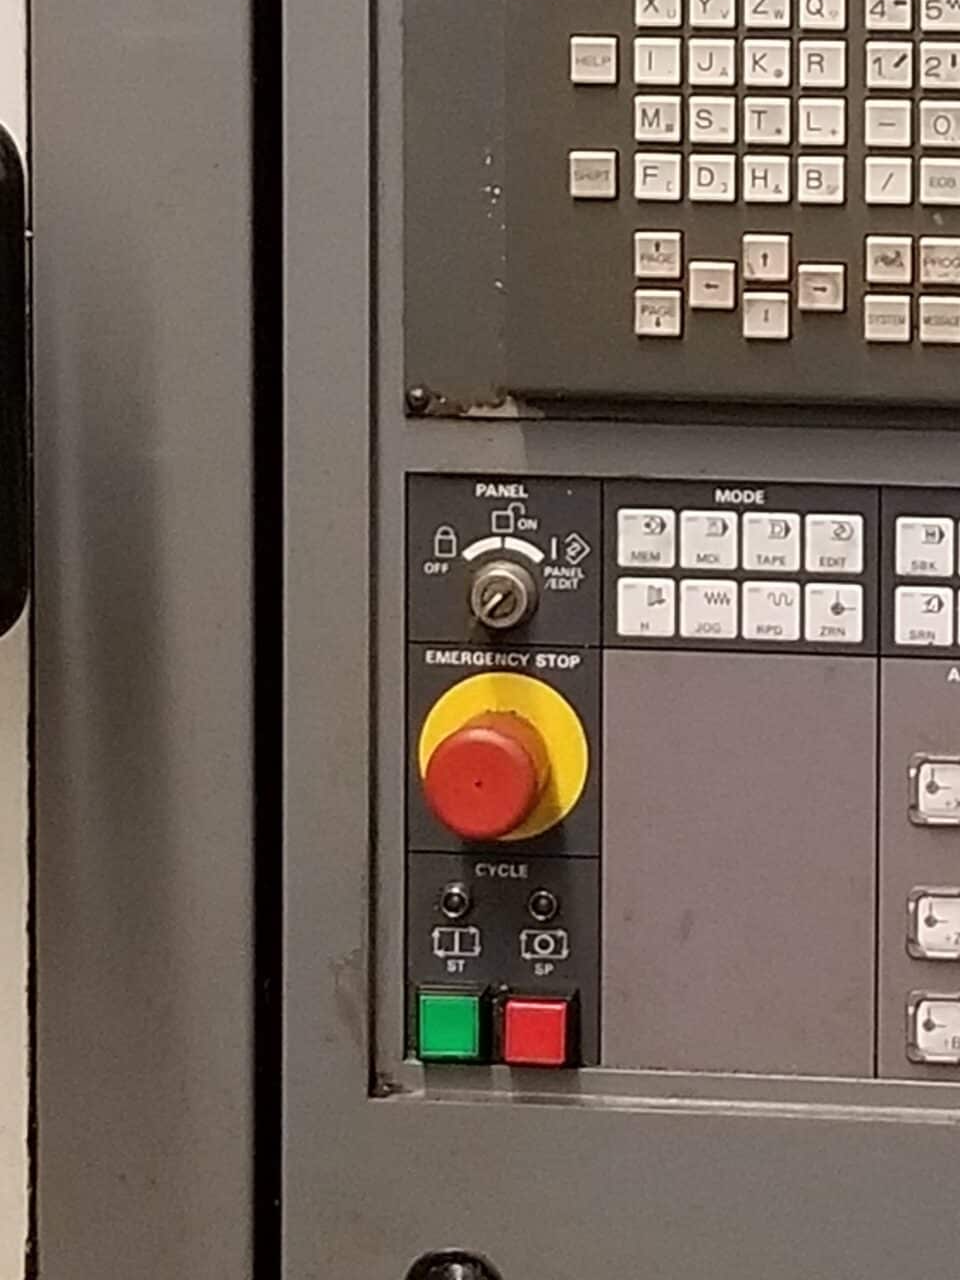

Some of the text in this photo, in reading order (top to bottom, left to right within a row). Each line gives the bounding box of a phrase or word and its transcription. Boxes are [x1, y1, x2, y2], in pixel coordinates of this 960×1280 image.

[869, 0, 886, 18] 4
[925, 0, 943, 20] 5
[575, 55, 611, 66] HELP
[697, 52, 713, 71] J
[752, 53, 767, 72] K
[808, 53, 824, 73] R
[872, 57, 883, 76] 1
[925, 56, 941, 77] 2
[641, 108, 659, 128] M
[695, 109, 713, 129] S
[751, 110, 768, 130] T
[807, 112, 822, 131] L
[642, 166, 659, 186] F
[698, 167, 714, 187] D
[751, 168, 768, 188] H
[806, 169, 823, 189] B
[476, 484, 528, 498] PANEL
[715, 489, 765, 504] MODE
[518, 520, 538, 531] ON
[631, 551, 660, 562] MEM
[696, 553, 720, 563] MDI
[756, 554, 787, 566] TAPE
[819, 556, 846, 568] EDIT
[911, 560, 937, 571] SBK
[424, 563, 449, 574] OFF
[544, 567, 584, 579] PANEL
[695, 623, 721, 634] JOG
[425, 650, 580, 668] EMERGENCY STOP
[475, 863, 529, 878] CYCLE
[447, 959, 465, 972] ST
[534, 963, 554, 976] SP
